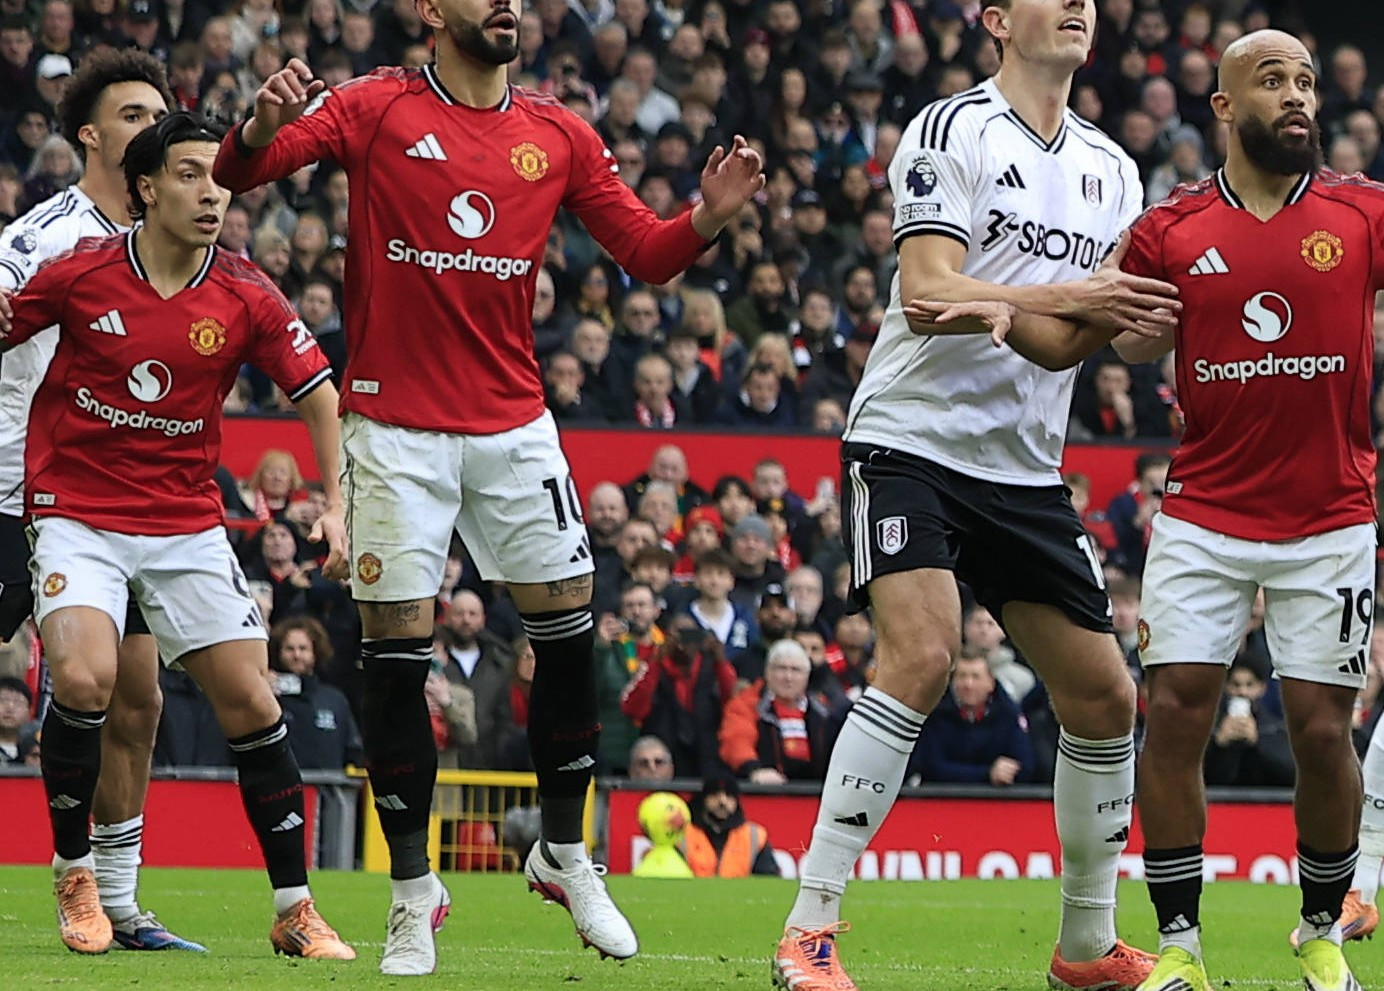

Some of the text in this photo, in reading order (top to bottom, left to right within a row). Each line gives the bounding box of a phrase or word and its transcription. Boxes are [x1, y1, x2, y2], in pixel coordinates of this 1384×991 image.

[1194, 352, 1345, 384] Snapdragon
[75, 387, 204, 437] Snapdragon
[1336, 587, 1374, 646] 19
[842, 774, 885, 794] FFC
[1097, 793, 1136, 814] FFC
